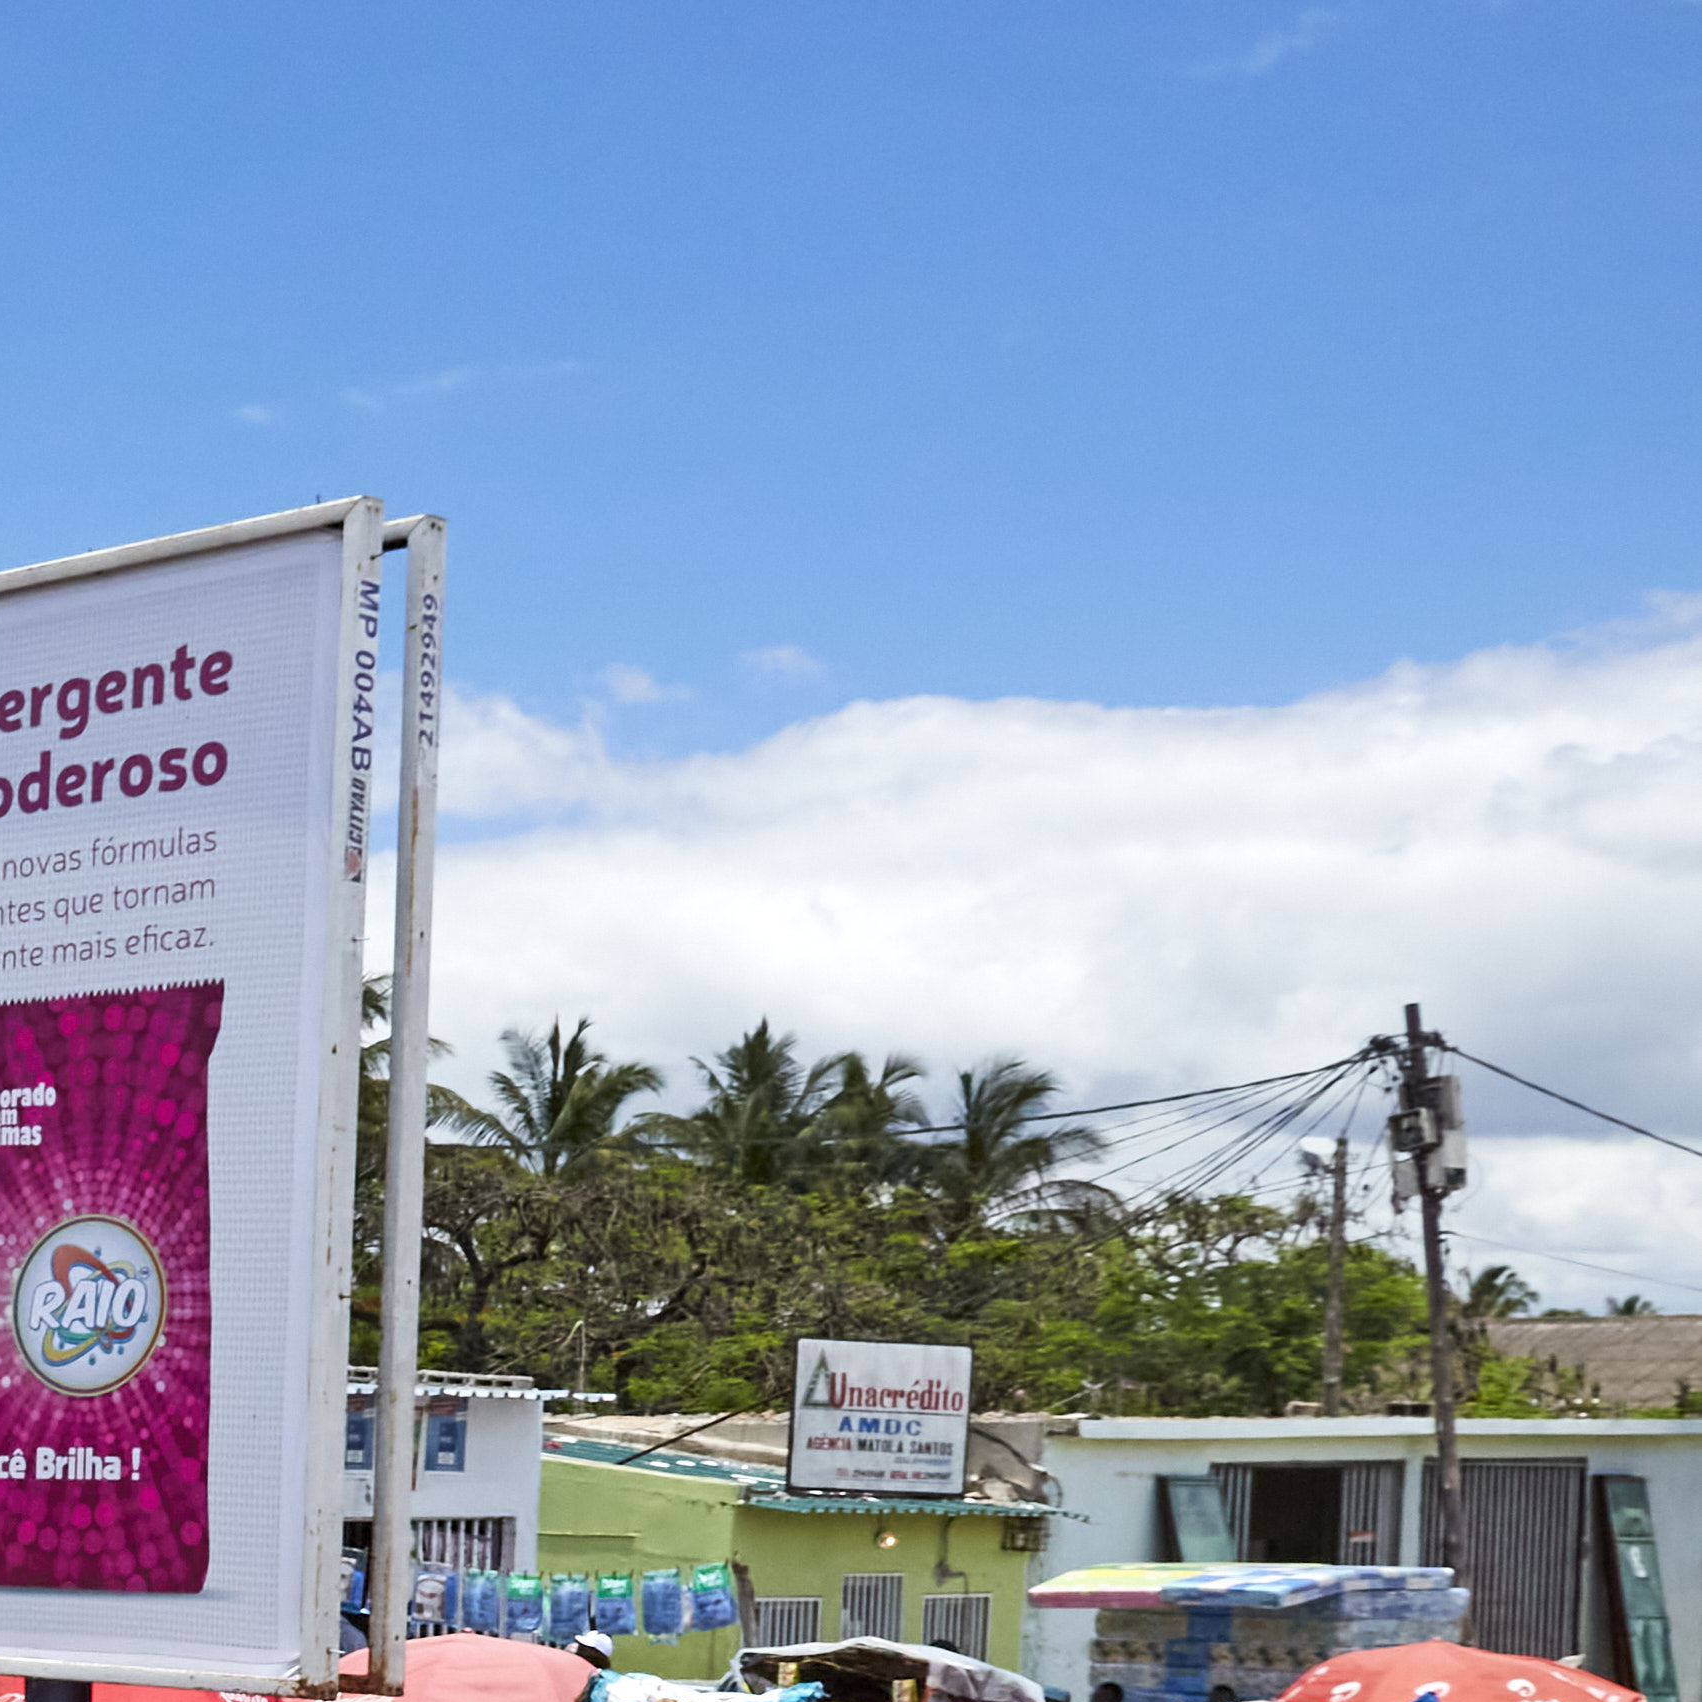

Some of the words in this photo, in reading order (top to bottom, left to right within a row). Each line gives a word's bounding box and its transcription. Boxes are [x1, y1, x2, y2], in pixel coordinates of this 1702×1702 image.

[359, 579, 380, 638] MP
[418, 594, 439, 747] 21492949
[351, 650, 376, 771] 004AB
[3, 848, 82, 879] novas
[91, 827, 217, 868] fórmulas
[53, 894, 103, 924] que
[113, 877, 216, 912] tornam
[52, 934, 117, 964] mais
[125, 923, 215, 956] eficaz.
[30, 1278, 148, 1331] RAIO
[830, 1372, 963, 1411] Unacrédito
[839, 1416, 922, 1436] AMDC
[35, 1446, 121, 1481] Brilha
[132, 1447, 141, 1481] !
